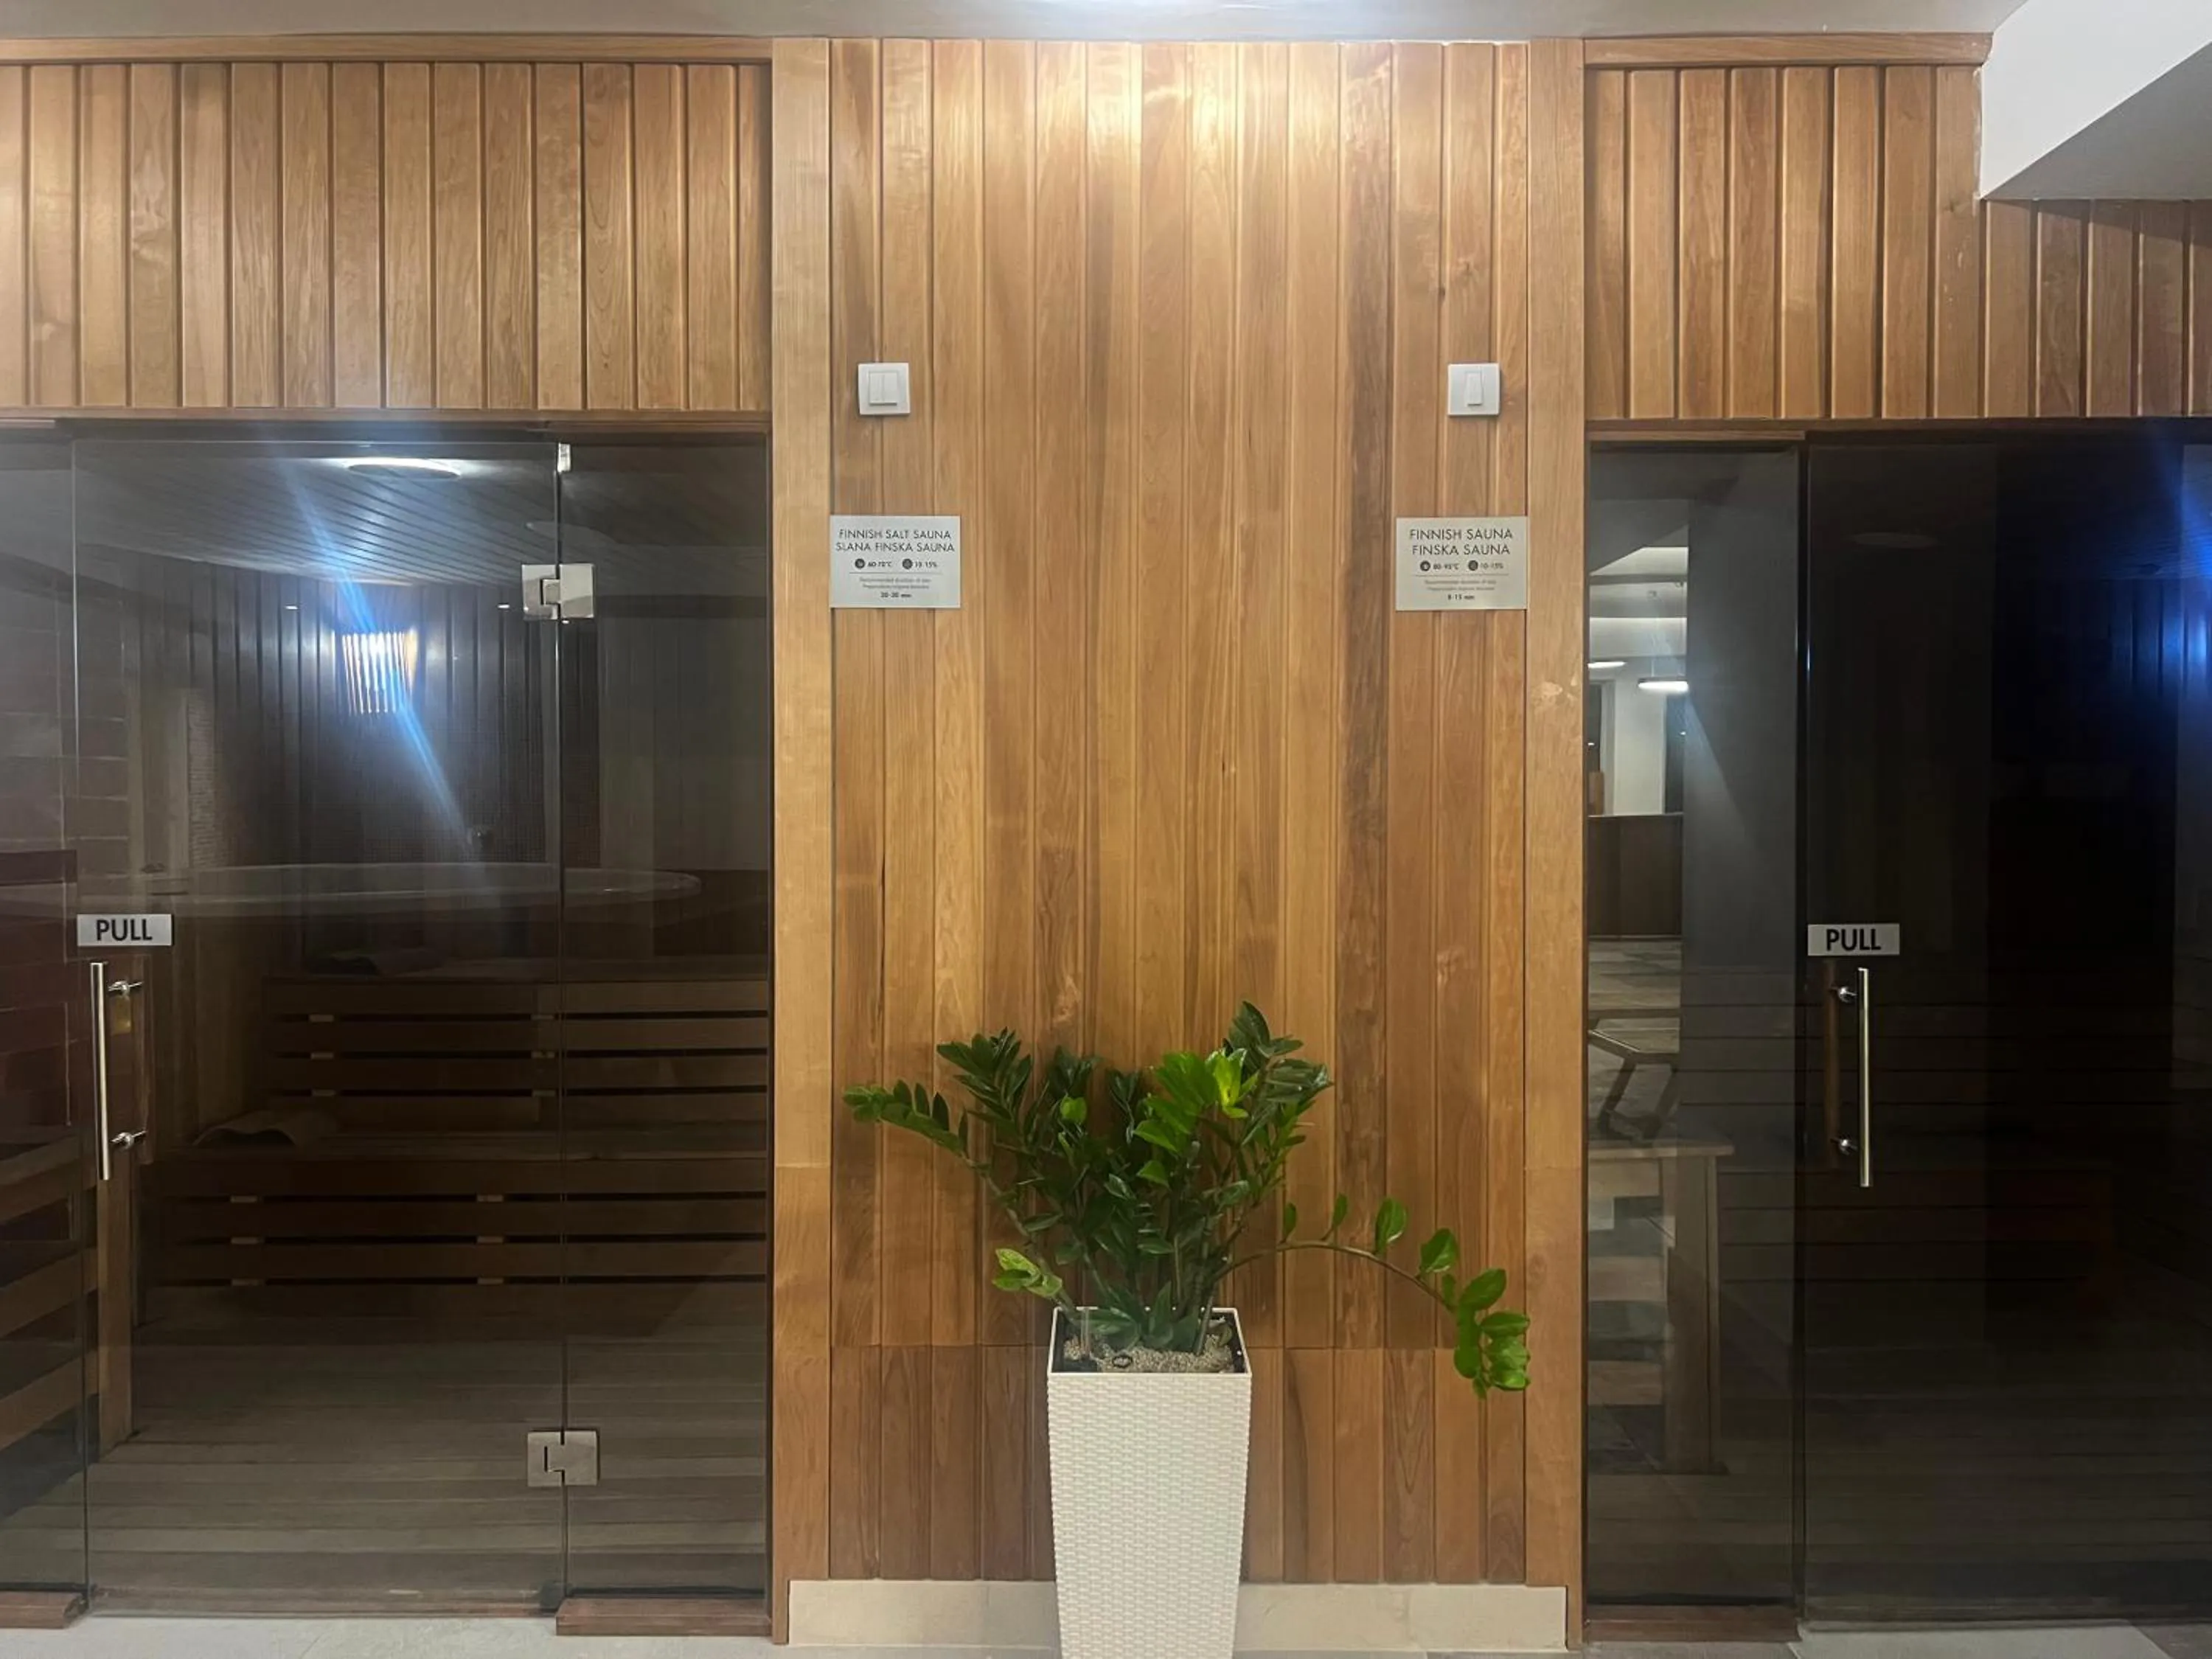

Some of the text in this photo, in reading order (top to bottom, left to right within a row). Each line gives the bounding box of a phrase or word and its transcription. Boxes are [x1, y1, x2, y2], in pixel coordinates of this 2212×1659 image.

[838, 529, 952, 540] FINNISH SALT SAUNA
[1409, 528, 1514, 540] FINNISH SAUNA
[875, 542, 914, 552] FINSKA
[917, 542, 956, 552] SAUNA
[1412, 543, 1511, 556] FINSKA SAUNA
[96, 919, 153, 941] PULL
[1826, 928, 1882, 951] PULL
